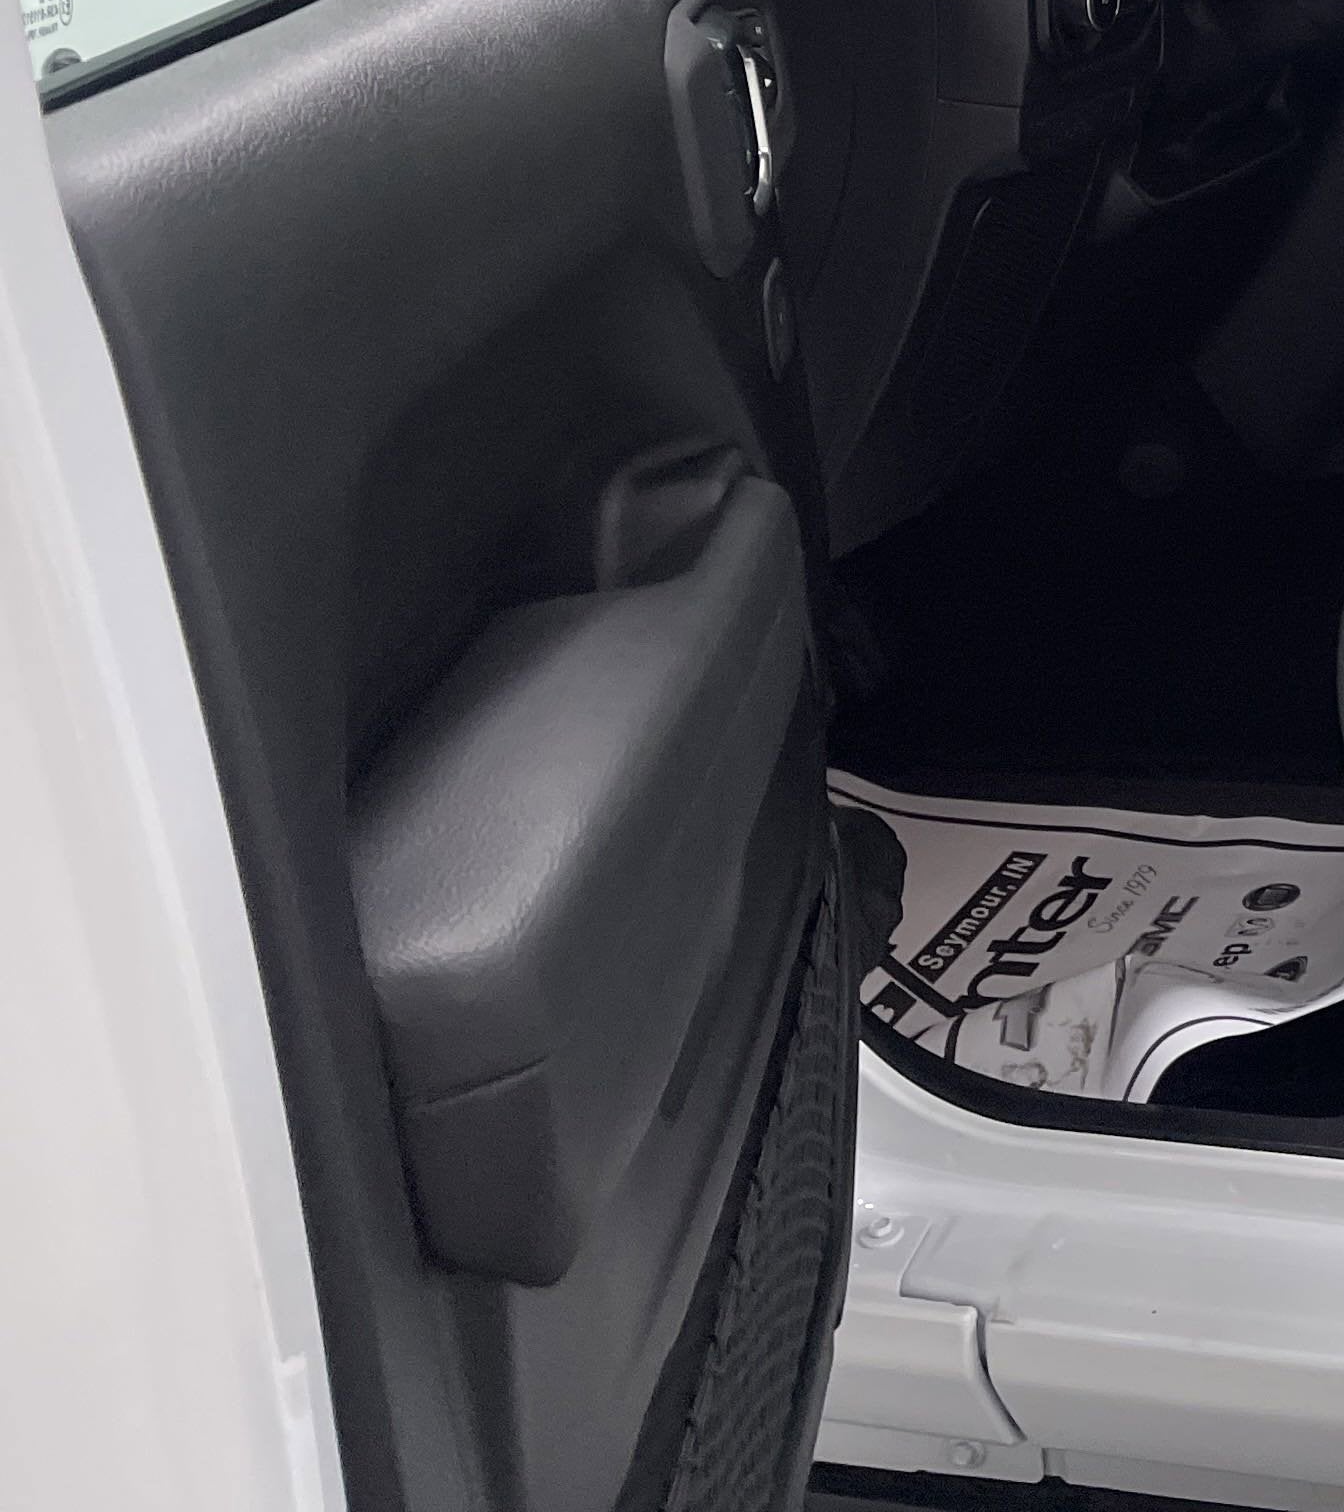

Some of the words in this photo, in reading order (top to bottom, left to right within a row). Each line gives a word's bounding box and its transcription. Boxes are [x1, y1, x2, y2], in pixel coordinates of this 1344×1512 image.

[916, 884, 1018, 971] Seymour,
[1001, 856, 1037, 881] IN
[1123, 863, 1158, 897] 1979
[955, 855, 1113, 1009] nter
[1212, 942, 1252, 969] ep
